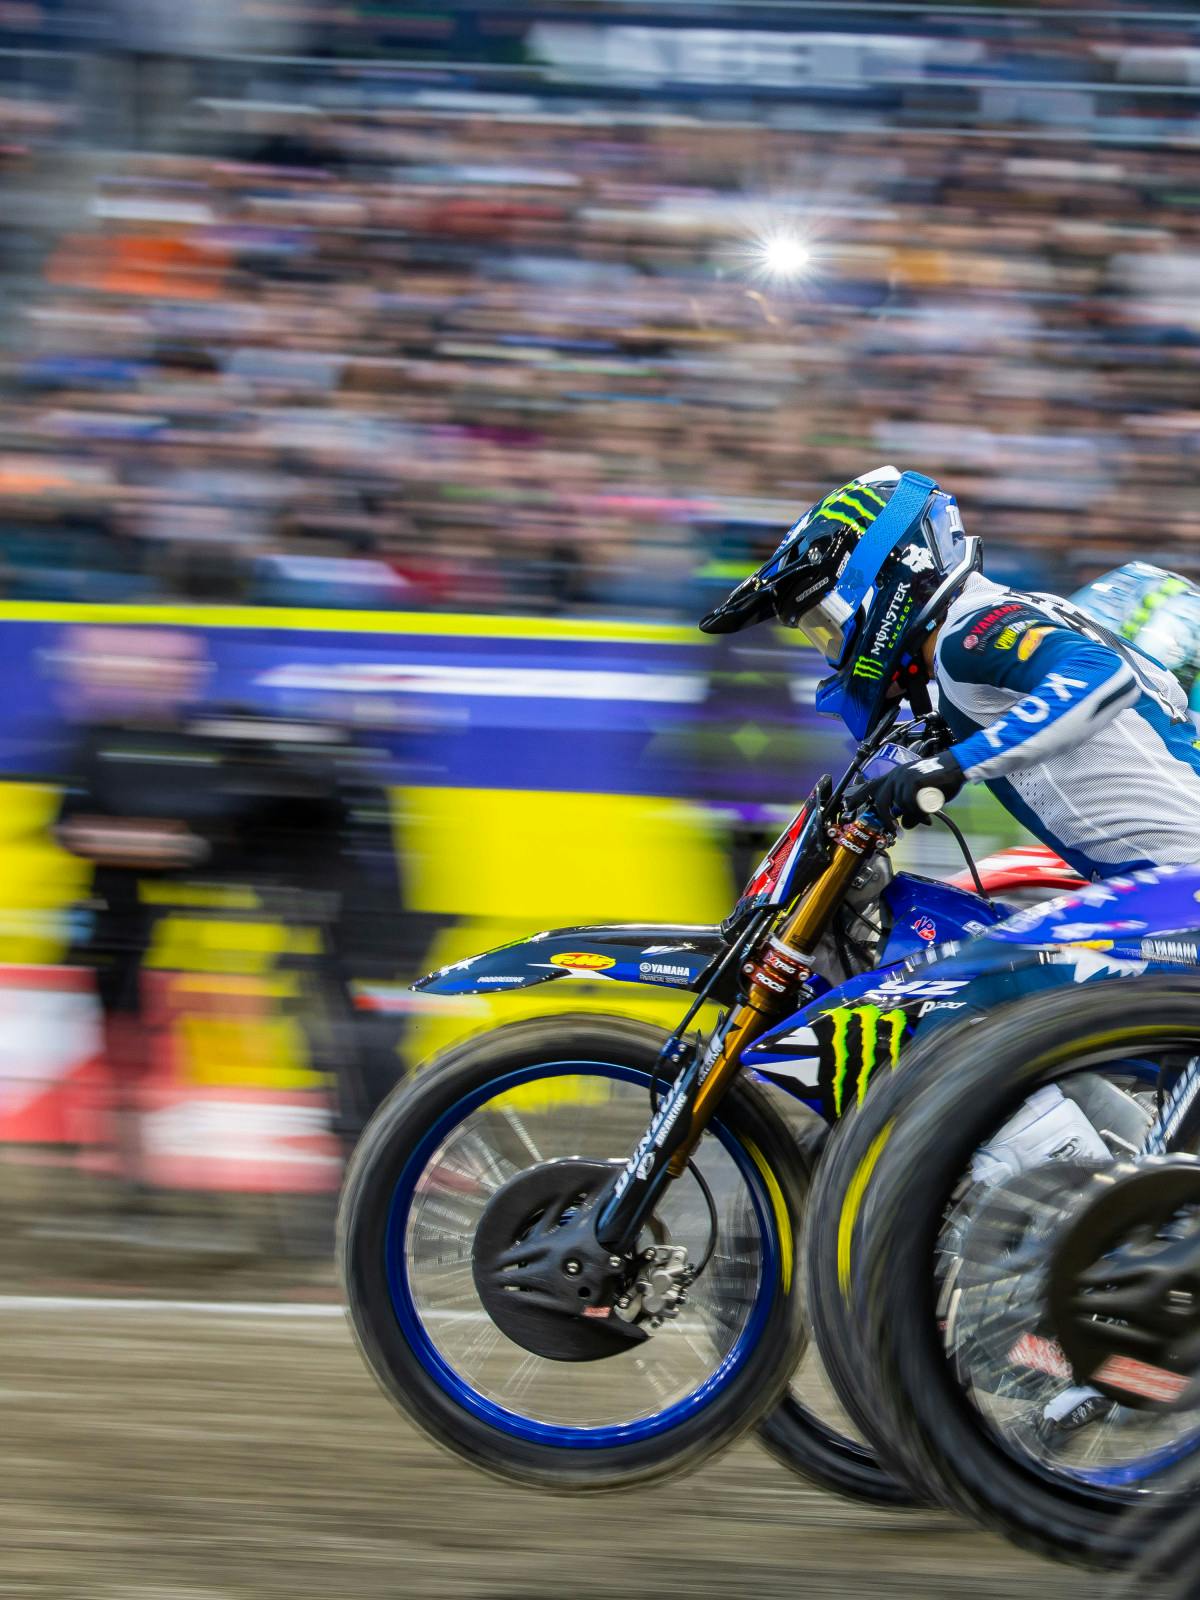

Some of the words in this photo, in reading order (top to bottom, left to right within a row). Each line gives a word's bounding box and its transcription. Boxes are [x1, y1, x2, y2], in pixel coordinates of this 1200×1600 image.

[870, 582, 911, 656] MONSTER
[888, 596, 913, 649] ENERGY
[970, 604, 1024, 635] YAMAHA
[651, 963, 690, 977] YAMAHA
[1154, 939, 1198, 960] YAMAHA
[653, 1090, 688, 1149] BRAKING
